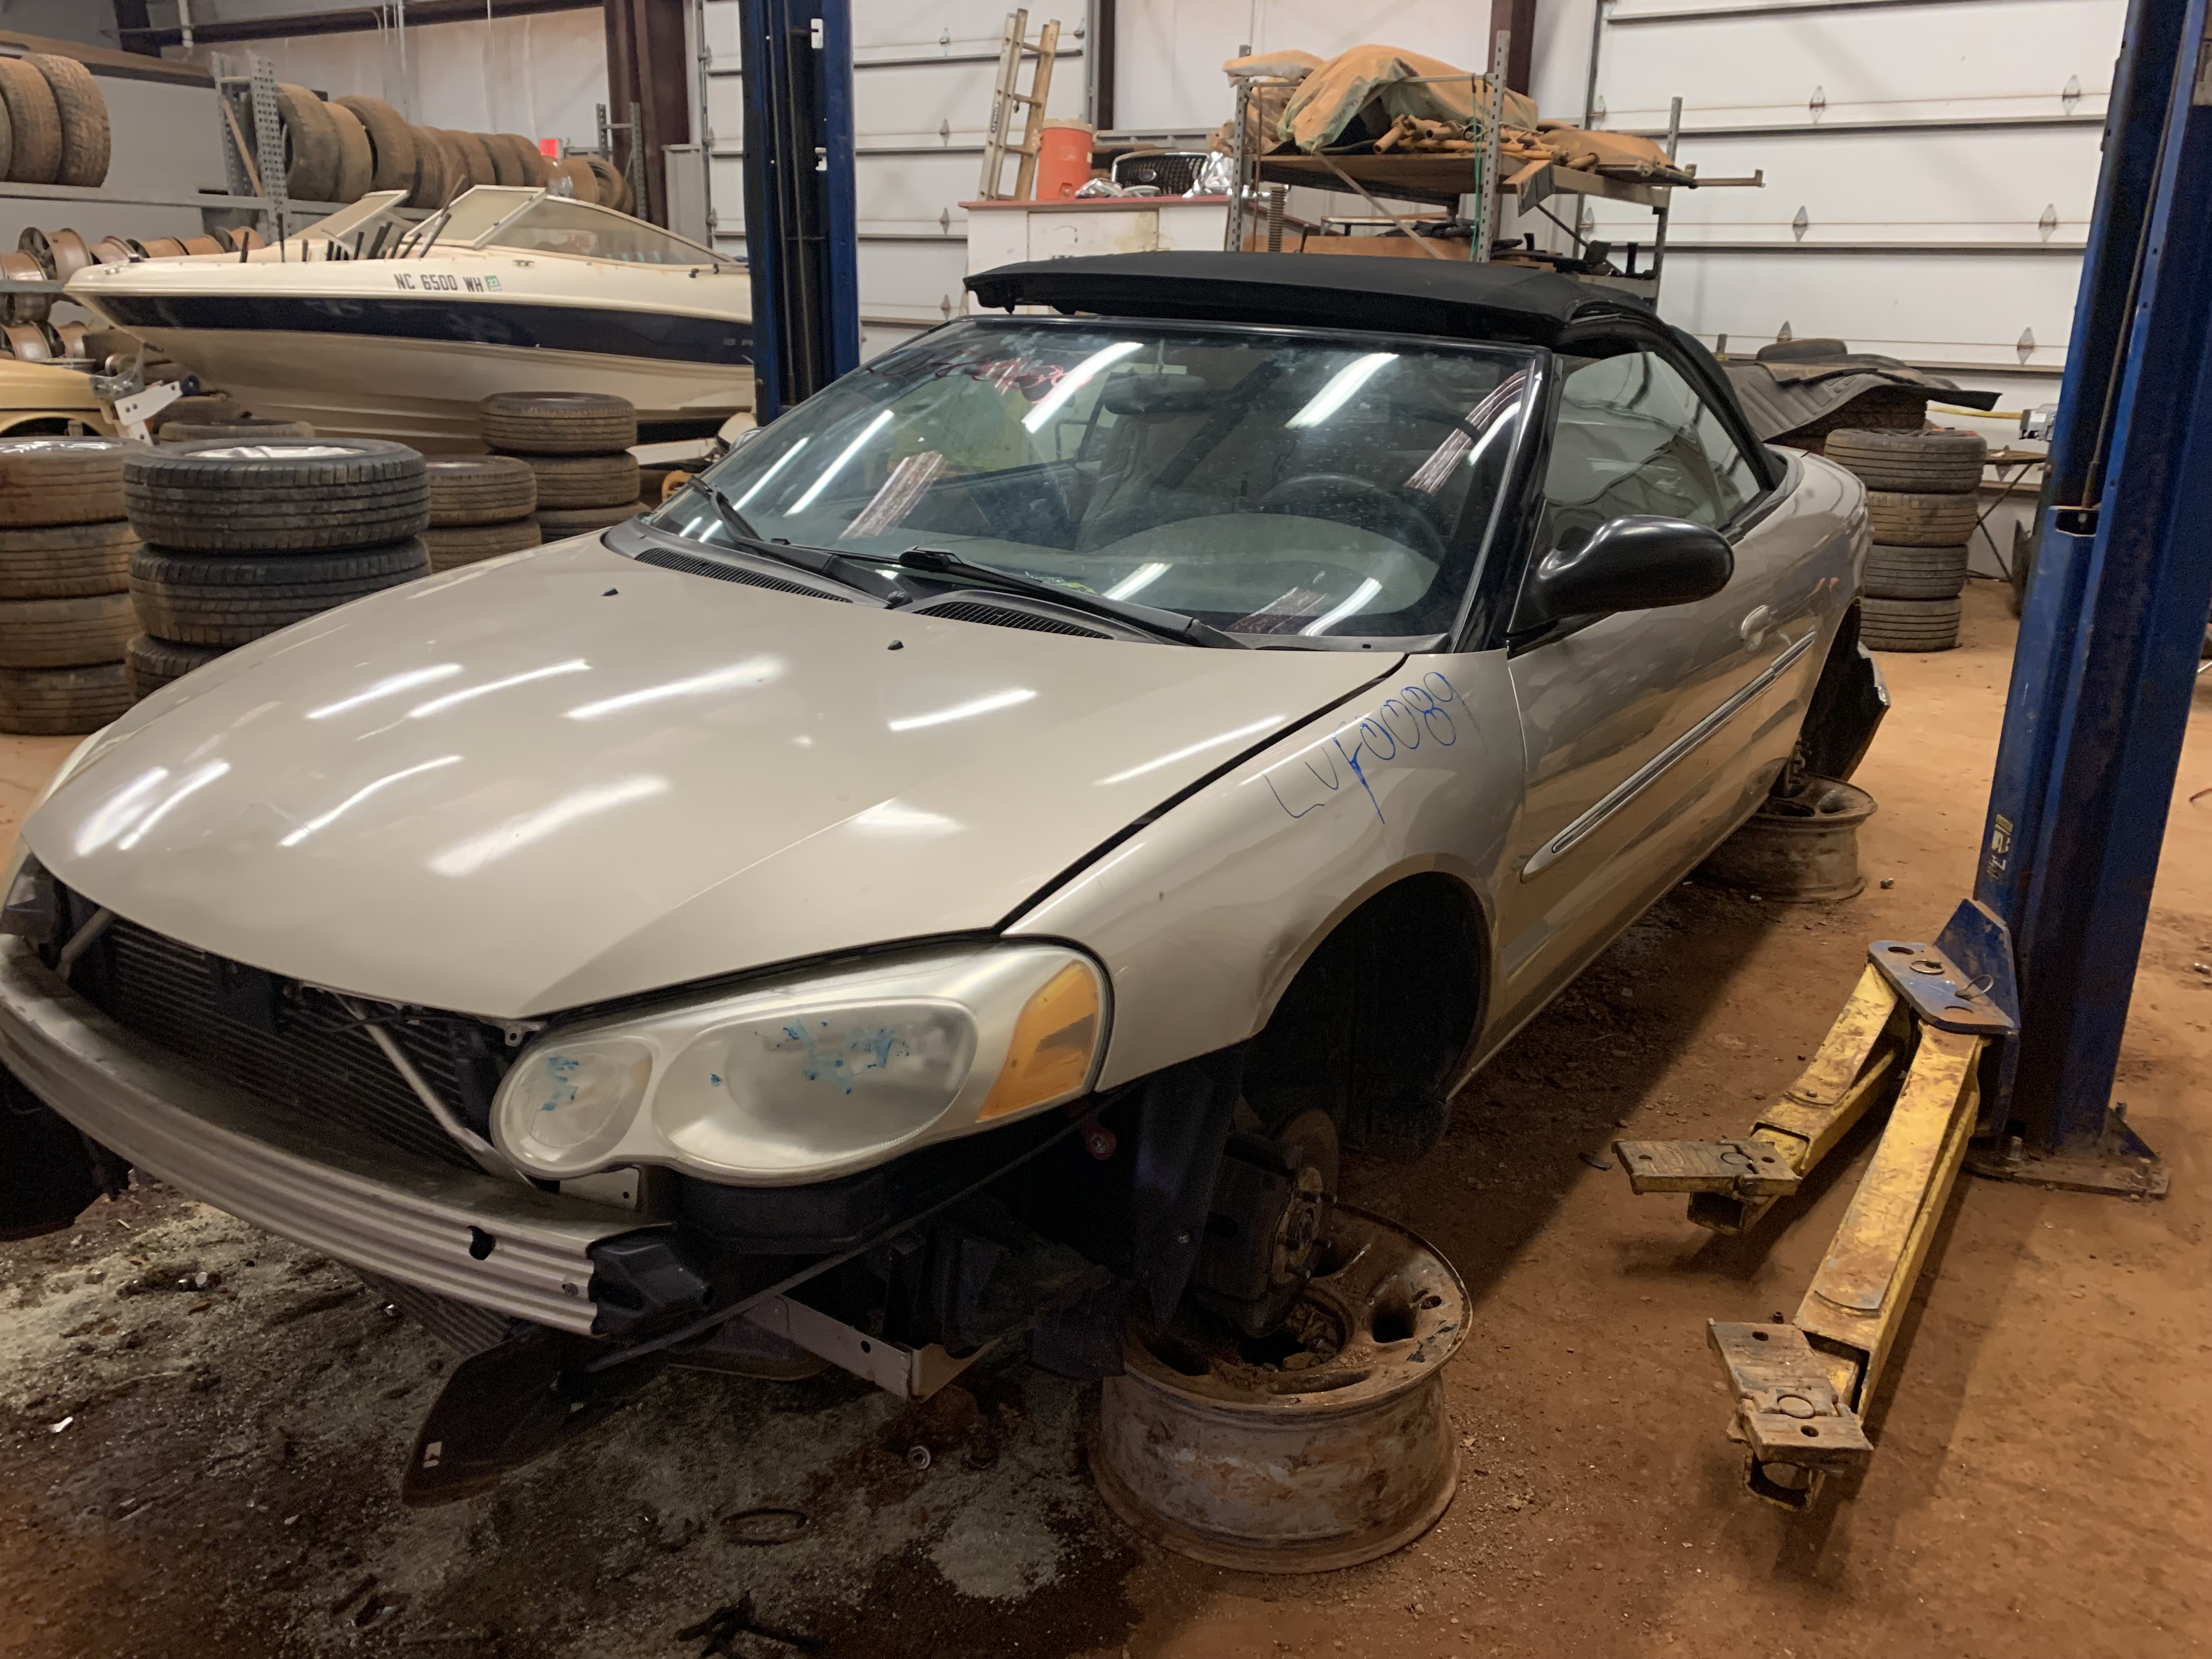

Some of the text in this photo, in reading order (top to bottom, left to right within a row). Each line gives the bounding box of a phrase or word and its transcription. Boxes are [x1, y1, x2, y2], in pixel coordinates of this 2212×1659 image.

[393, 273, 484, 292] NC 6500 WH
